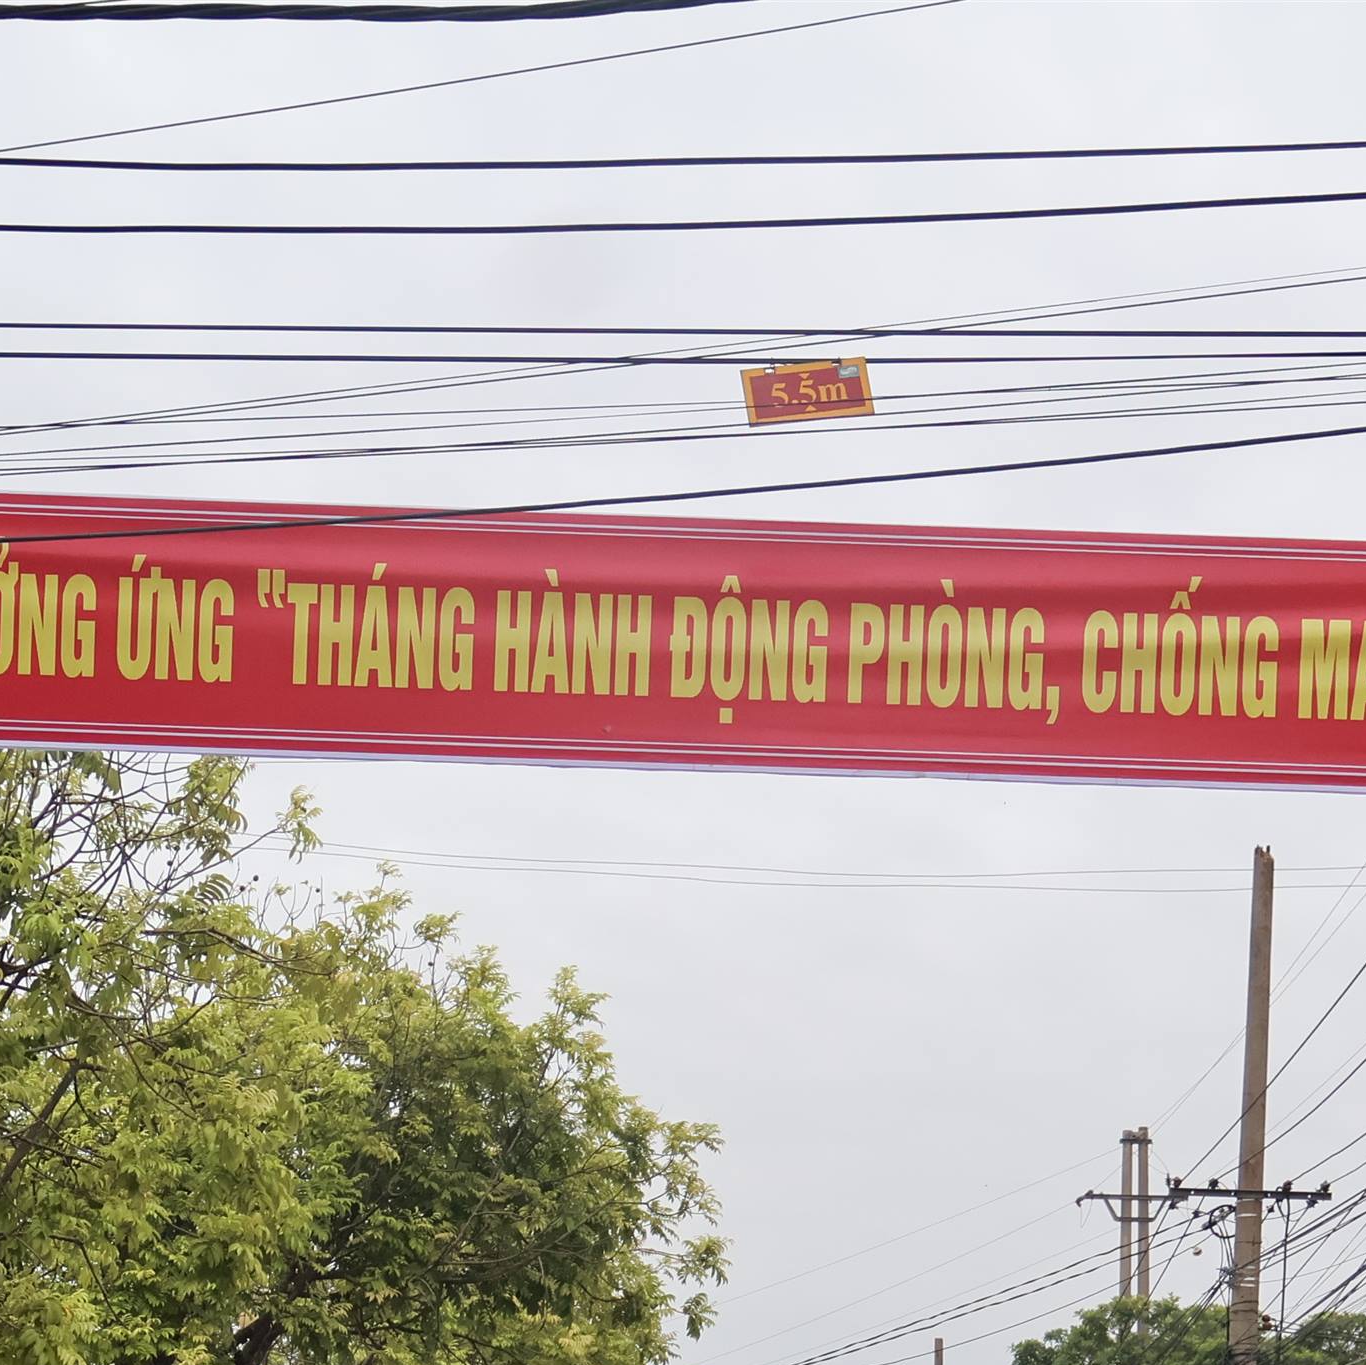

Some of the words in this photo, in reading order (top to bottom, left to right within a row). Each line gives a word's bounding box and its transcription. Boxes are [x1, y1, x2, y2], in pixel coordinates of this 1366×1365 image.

[771, 379, 848, 408] 5.5m
[117, 555, 235, 683] ỨNG
[495, 571, 652, 696] HÀNH
[671, 577, 828, 724] ĐỘNG
[848, 581, 1060, 723] PHÒNG,
[1083, 577, 1280, 718] CHỐNG
